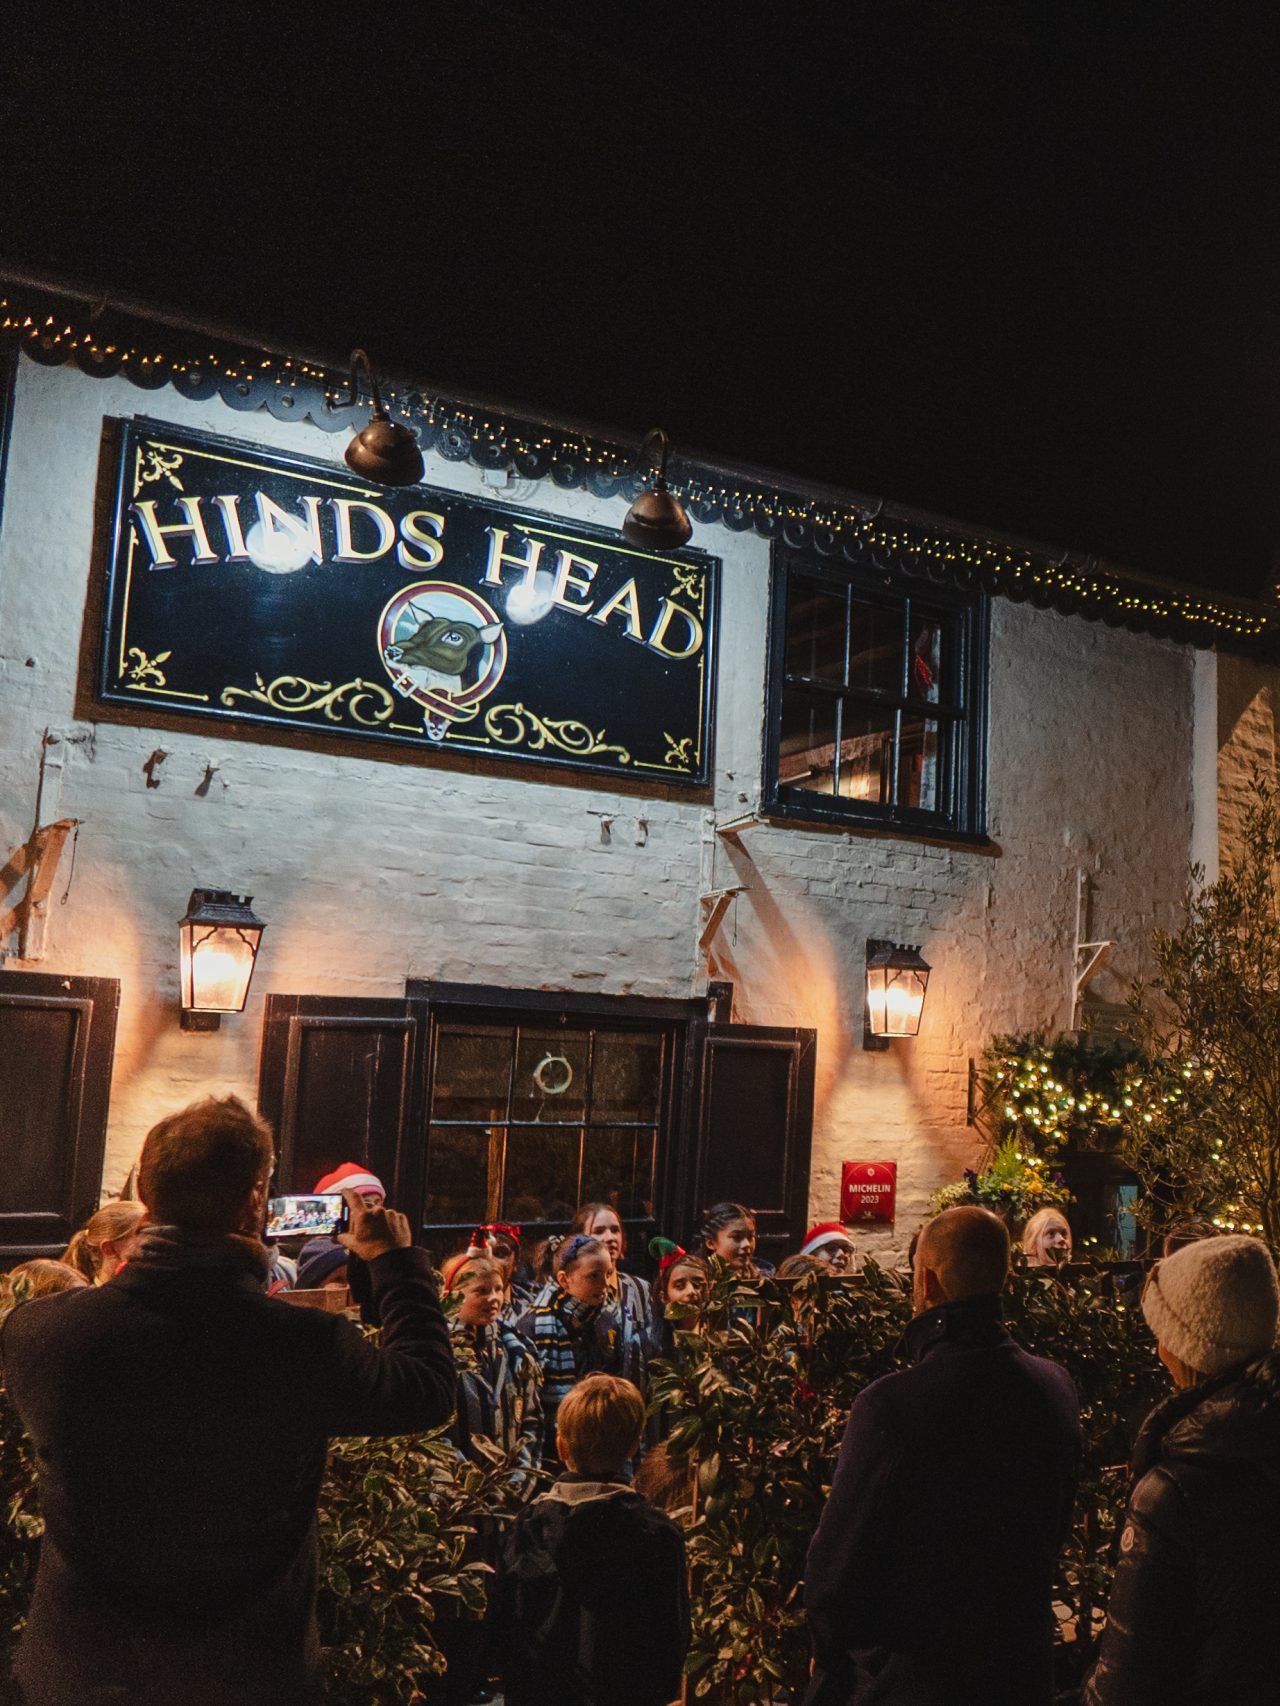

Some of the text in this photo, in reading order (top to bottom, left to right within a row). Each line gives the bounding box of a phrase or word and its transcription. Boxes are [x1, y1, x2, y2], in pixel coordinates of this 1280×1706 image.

[130, 490, 704, 660] HINDS HEAD
[849, 1184, 891, 1193] MICHELIN
[860, 1195, 879, 1204] 2023
